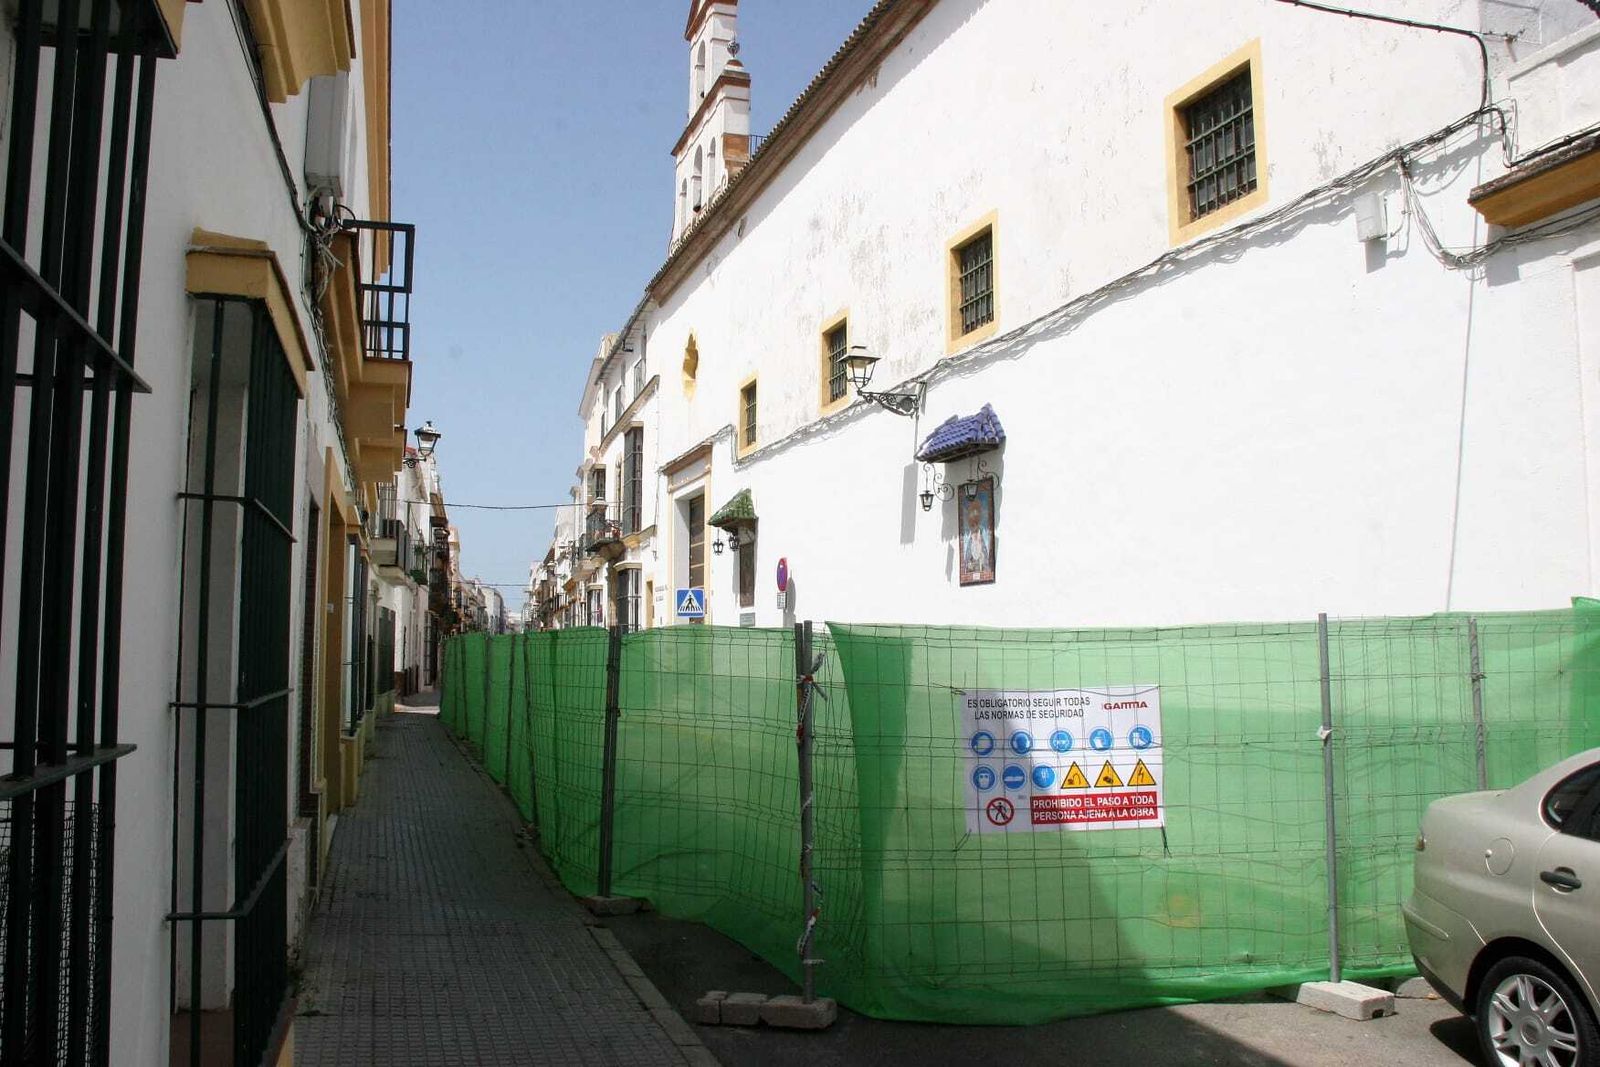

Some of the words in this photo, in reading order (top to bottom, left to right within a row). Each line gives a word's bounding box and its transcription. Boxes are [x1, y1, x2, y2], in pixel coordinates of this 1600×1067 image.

[967, 699, 978, 708] ES
[979, 698, 1031, 708] OBLIGATORIO
[1064, 697, 1090, 706] TODAS
[974, 710, 990, 720] LAS
[991, 710, 1024, 720] NORMAS
[1026, 710, 1036, 719] DE
[1038, 709, 1084, 719] SEGURIDAD
[1033, 798, 1082, 808] PROHIBIDO
[1084, 797, 1095, 807] EL
[1097, 796, 1121, 806] PASO
[1122, 796, 1129, 805] A
[1131, 795, 1155, 805] TODA
[1033, 810, 1077, 821] PERSONA
[1078, 809, 1107, 820] AJENA
[1108, 808, 1116, 818] A
[1116, 808, 1128, 818] LA
[1129, 807, 1155, 817] OBRA
